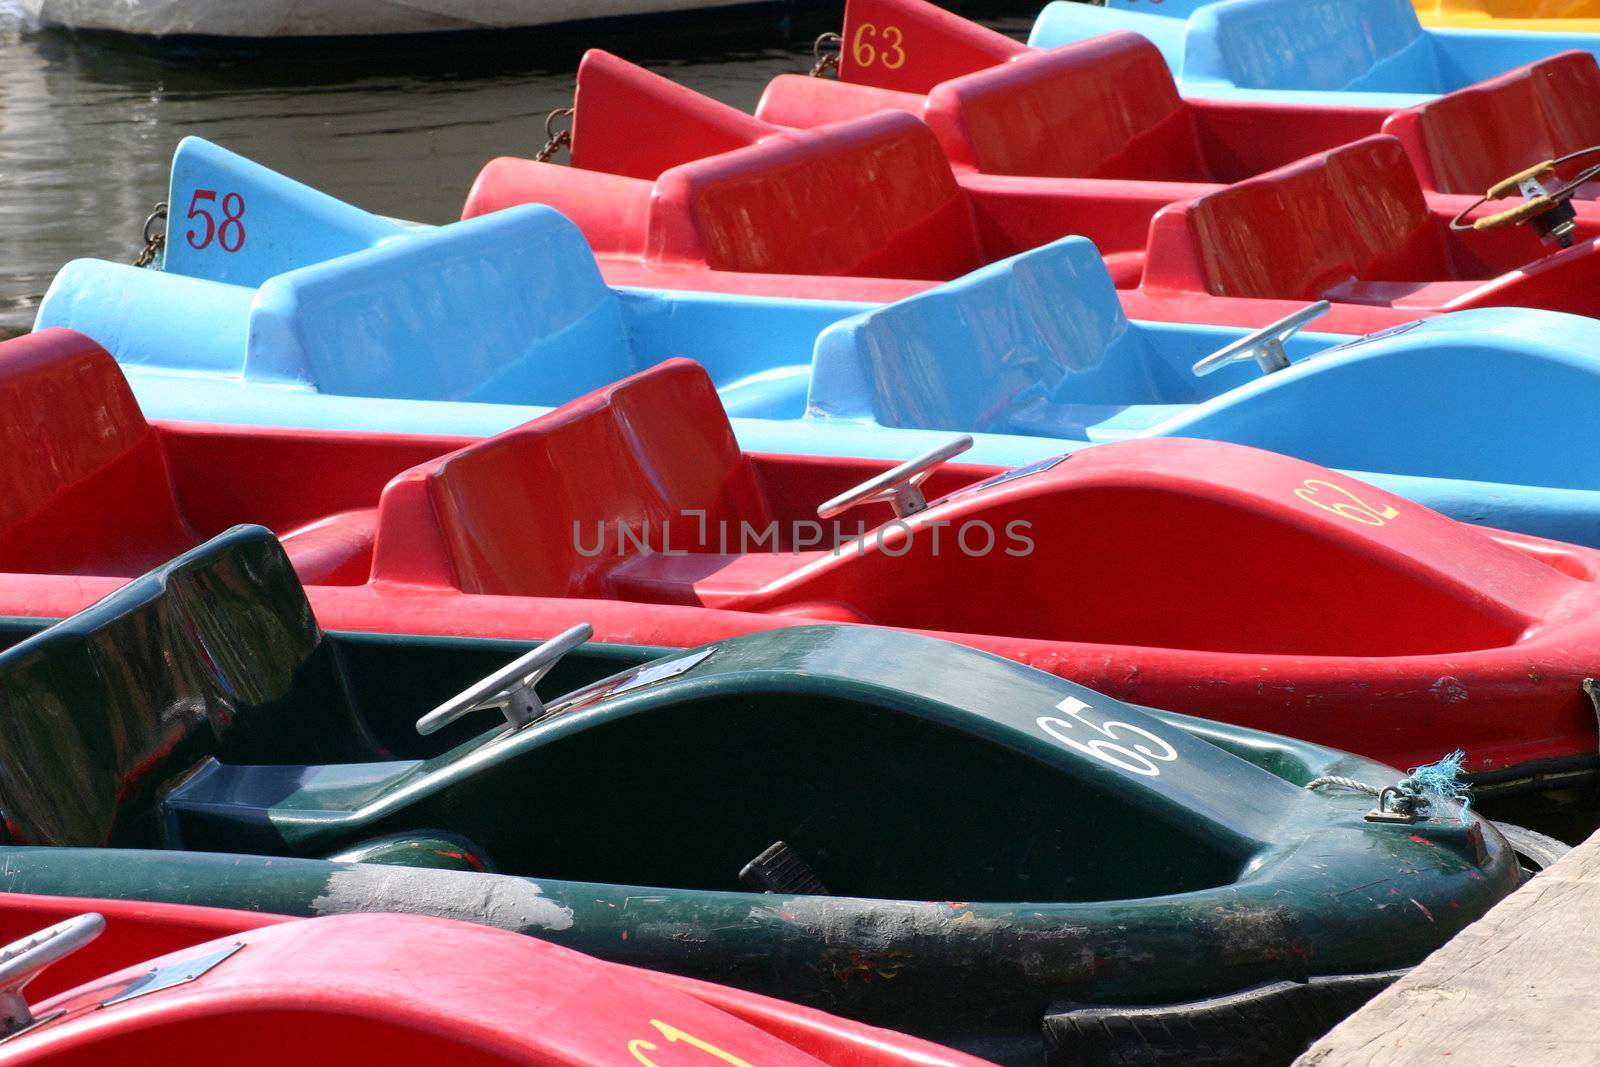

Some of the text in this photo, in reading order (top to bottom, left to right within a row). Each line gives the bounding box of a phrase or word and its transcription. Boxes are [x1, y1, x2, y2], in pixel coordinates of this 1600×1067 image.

[853, 23, 905, 69] 63
[187, 189, 246, 253] 58
[1294, 480, 1400, 526] 62
[1036, 696, 1177, 776] 65
